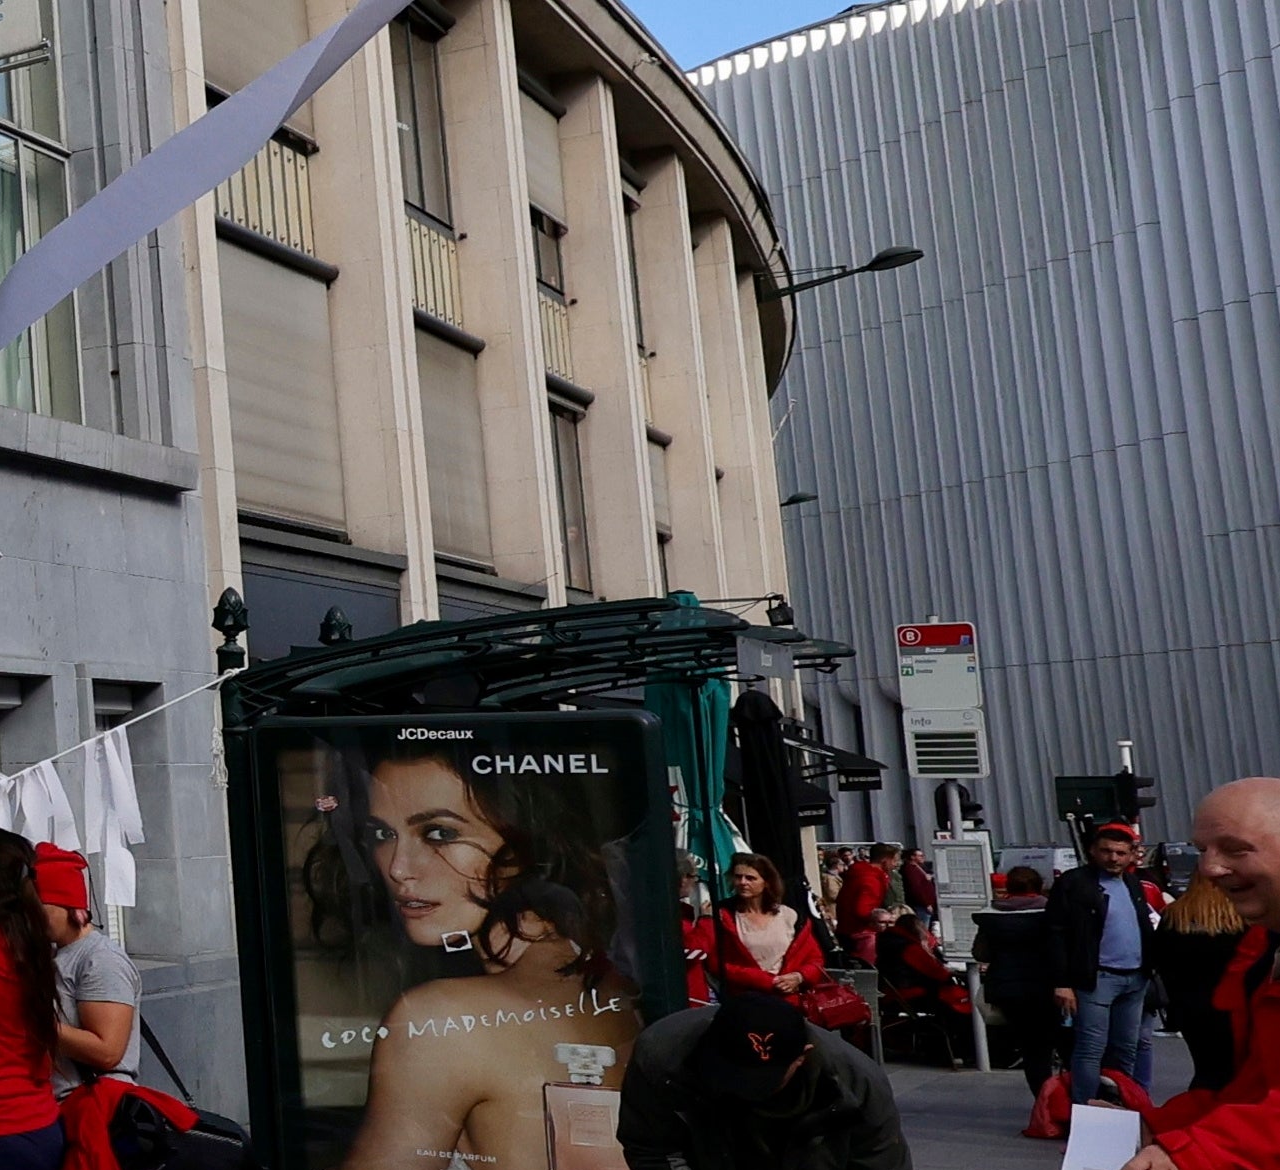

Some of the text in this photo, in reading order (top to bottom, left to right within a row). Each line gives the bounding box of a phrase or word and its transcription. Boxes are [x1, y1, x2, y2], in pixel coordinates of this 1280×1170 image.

[905, 631, 916, 641] B
[396, 727, 474, 741] JCDecaux
[471, 753, 610, 775] CHANEL
[416, 1148, 497, 1164] EAU DE PARFUM
